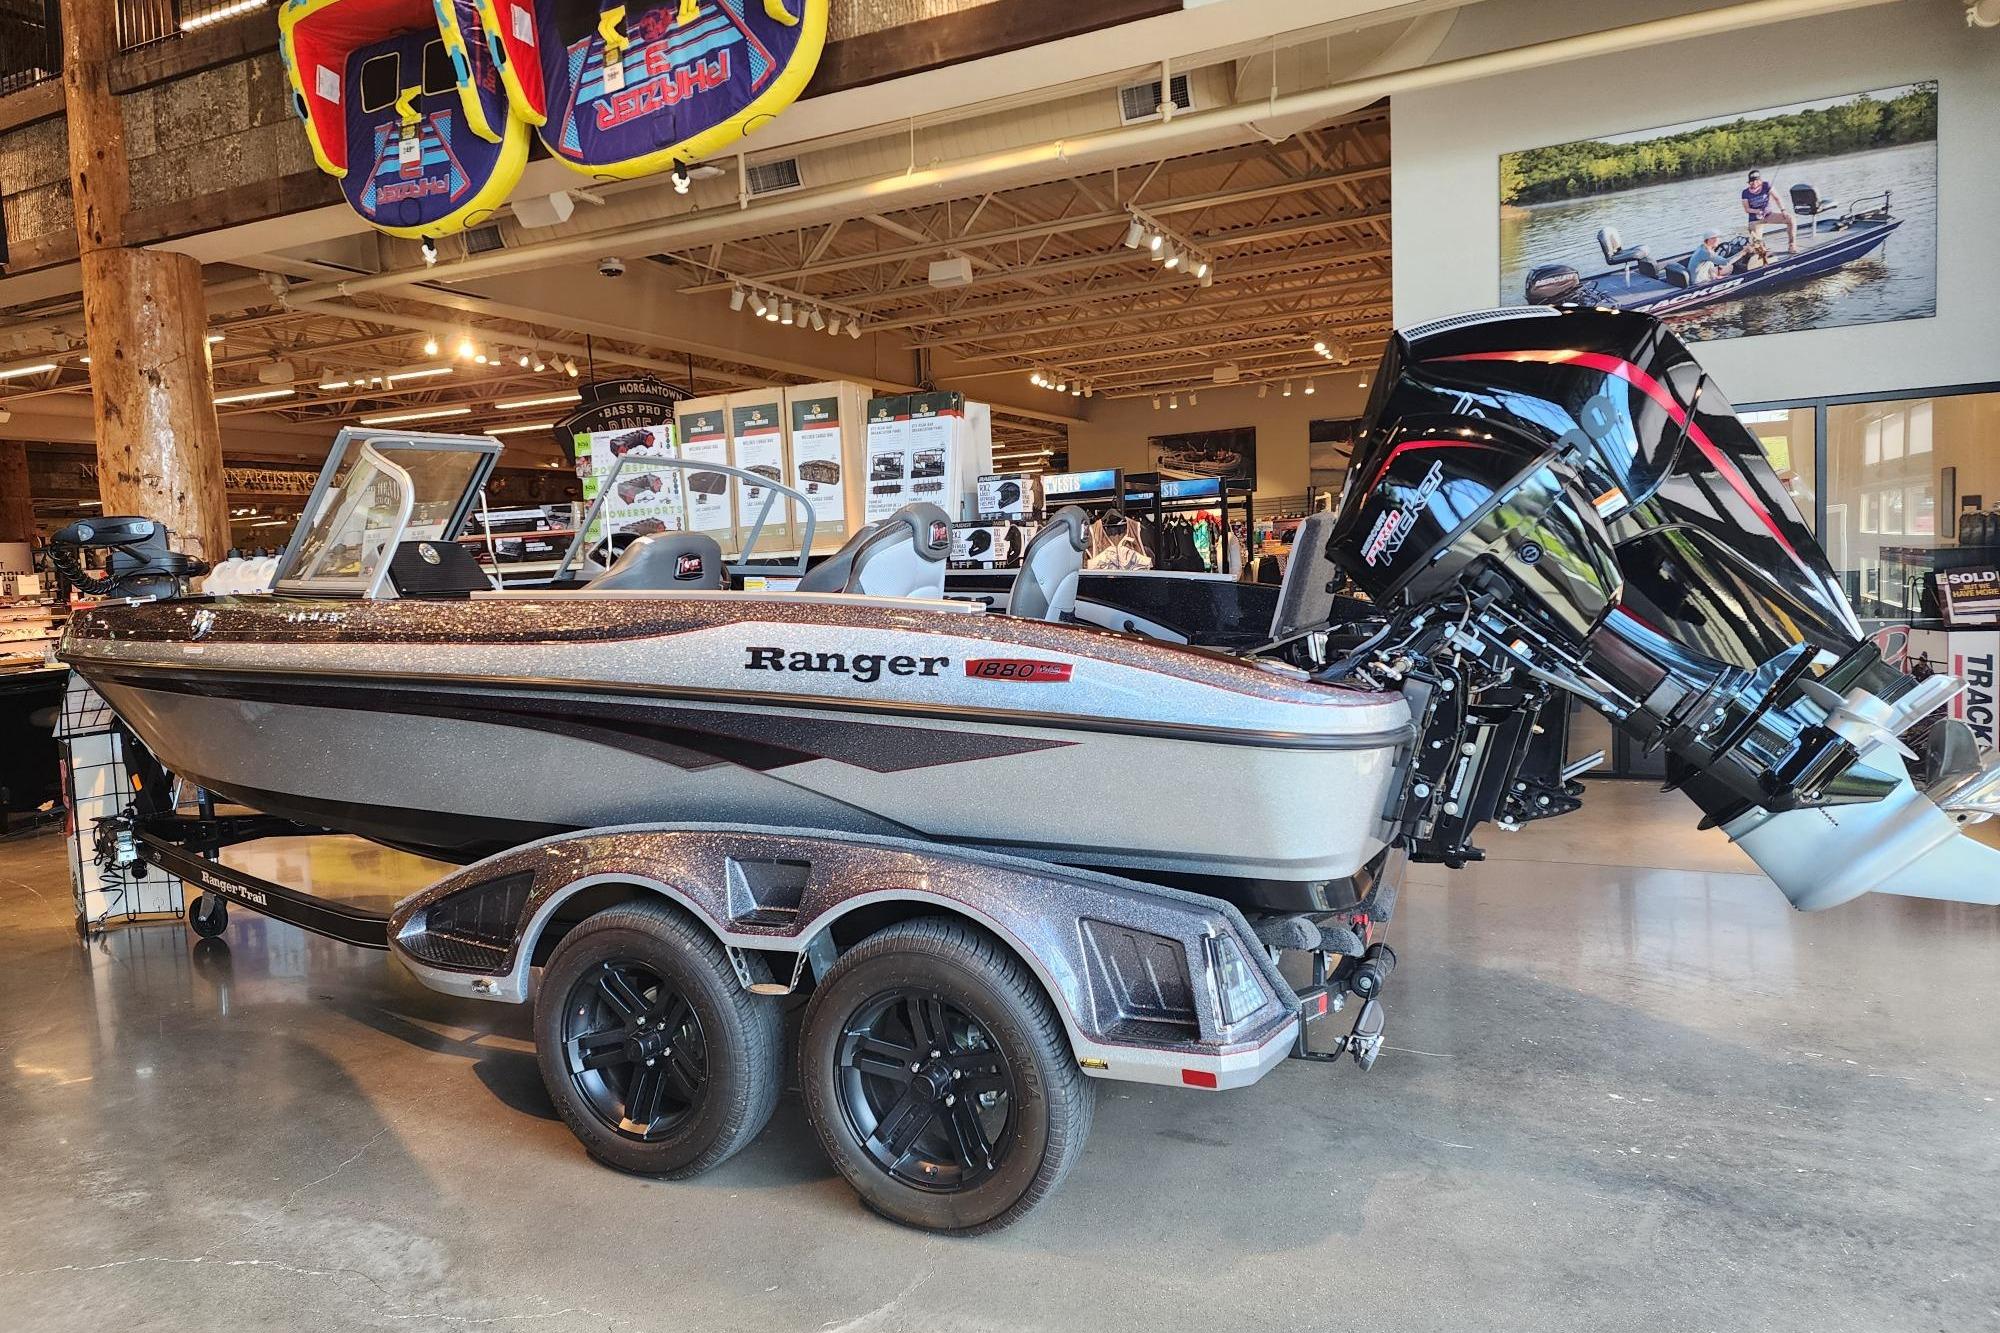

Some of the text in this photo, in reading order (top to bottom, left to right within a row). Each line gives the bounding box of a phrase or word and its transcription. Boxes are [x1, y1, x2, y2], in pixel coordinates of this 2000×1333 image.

[644, 39, 672, 75] 3
[592, 48, 731, 131] PHAZER
[377, 174, 450, 205] PHAZER
[619, 383, 684, 401] MORGANTOWN
[604, 404, 634, 418] BASS
[638, 404, 660, 416] PRO
[244, 471, 293, 485] ARTIST
[1051, 476, 1080, 492] VESTS
[1161, 483, 1179, 496] STS
[1949, 571, 1996, 584] SOLD
[1952, 590, 1975, 598] HAVE
[744, 646, 950, 683] Ranger
[974, 661, 1035, 678] 1880
[1966, 653, 1993, 754] TRACK
[201, 870, 268, 906] Ranger Trail
